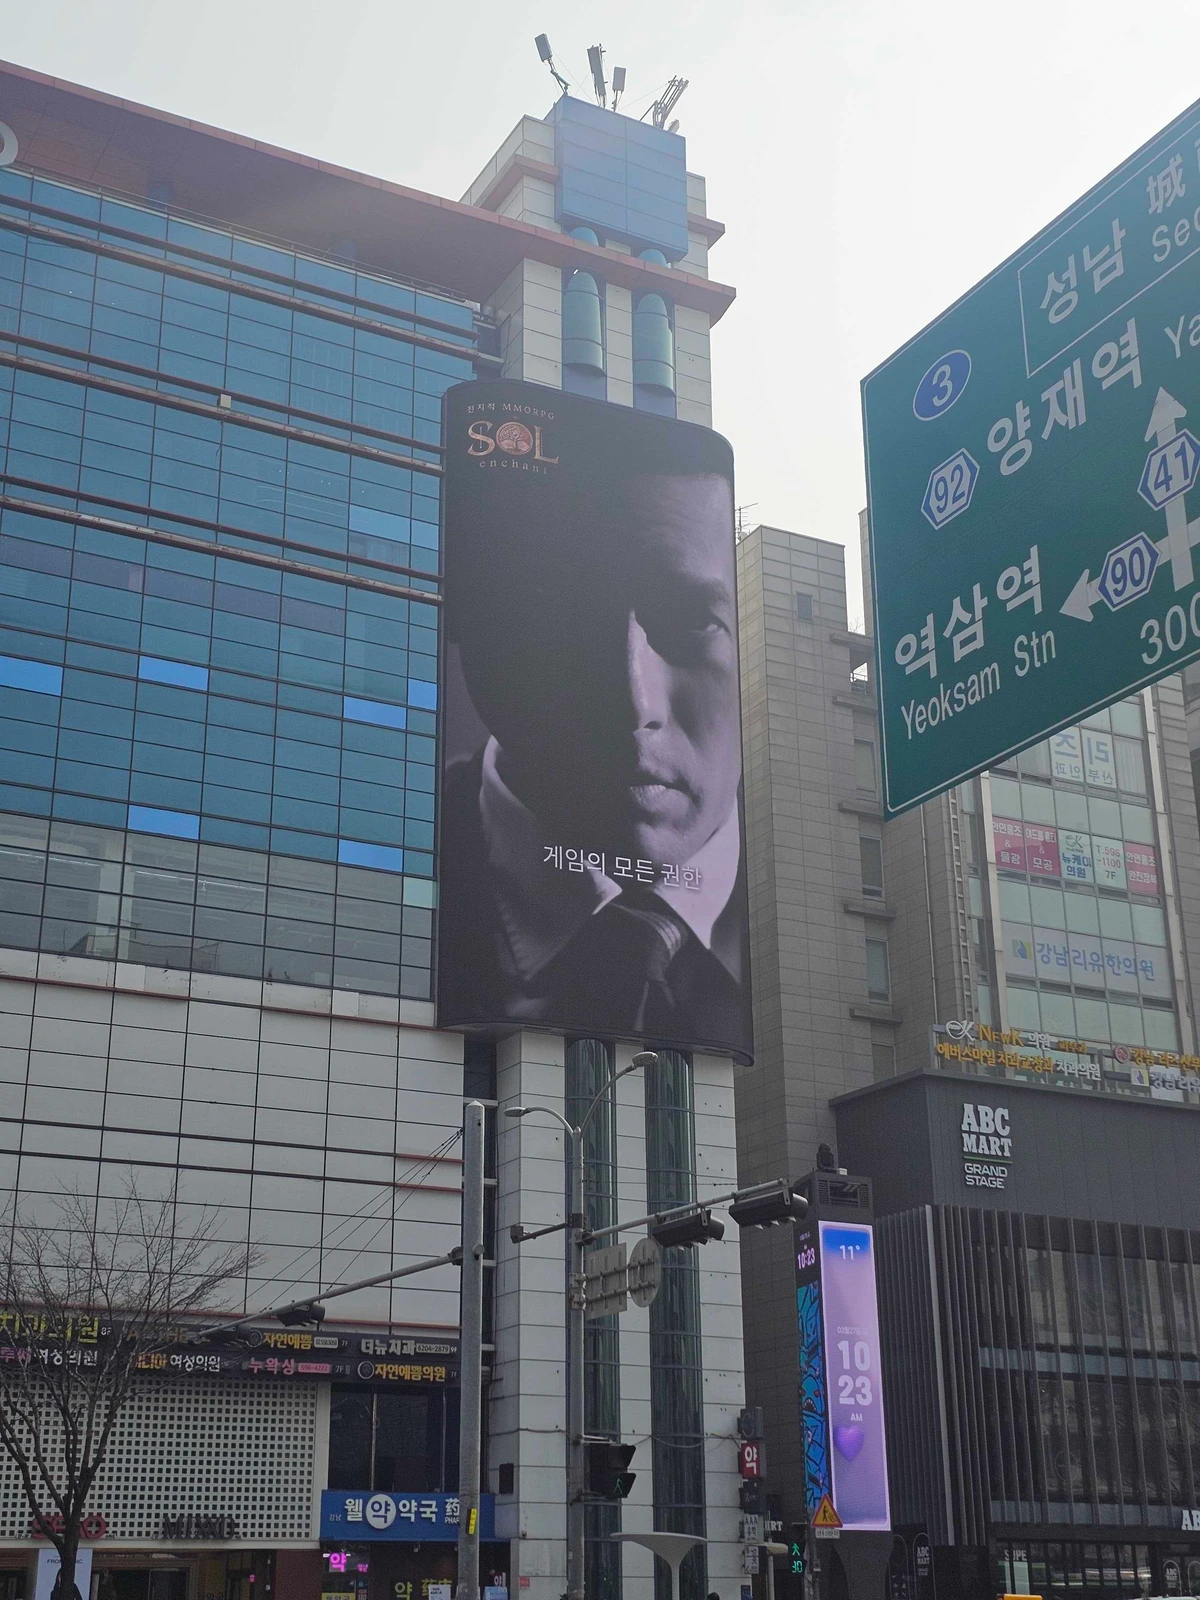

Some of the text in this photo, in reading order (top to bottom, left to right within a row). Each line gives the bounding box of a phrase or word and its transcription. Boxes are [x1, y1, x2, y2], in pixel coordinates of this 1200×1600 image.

[1146, 139, 1200, 214] 城
[1040, 218, 1126, 323] 성남
[932, 365, 952, 406] 3
[987, 317, 1142, 475] 양재역
[502, 403, 555, 420] MMORPG
[467, 420, 559, 464] SOL
[479, 459, 548, 475] enchant
[1153, 441, 1191, 492] 41
[934, 464, 964, 513] 92
[1111, 546, 1145, 597] 90
[895, 545, 1042, 678] 역삼역
[901, 630, 1056, 739] Yeoksam Stn
[543, 846, 702, 891] 게임의 모든 권한
[1033, 858, 1053, 871] 모공
[1062, 852, 1091, 868] 뉴케이
[1066, 865, 1086, 879] 의원
[1105, 870, 1116, 880] 7F
[1036, 942, 1155, 982] 강남리유한의원
[1027, 1032, 1051, 1051] 의원
[936, 1042, 995, 1067] 에버스마일
[1056, 1060, 1101, 1080] 치과의원
[1131, 1047, 1154, 1066] 강남
[961, 1103, 1011, 1137] ABC
[962, 1133, 1012, 1157] MART
[964, 1163, 1008, 1178] GRAND
[965, 1175, 1005, 1189] STAGE
[797, 1247, 815, 1270] 10:23
[263, 1332, 312, 1350] 자연예쁨
[170, 1355, 220, 1372] 여성의원
[837, 1340, 871, 1371] 10
[336, 1365, 345, 1374] 7F
[375, 1364, 446, 1382] 자연예쁨의원
[839, 1375, 873, 1406] 23
[850, 1413, 863, 1422] AM
[745, 1446, 758, 1474] 약
[330, 1553, 347, 1573] 약
